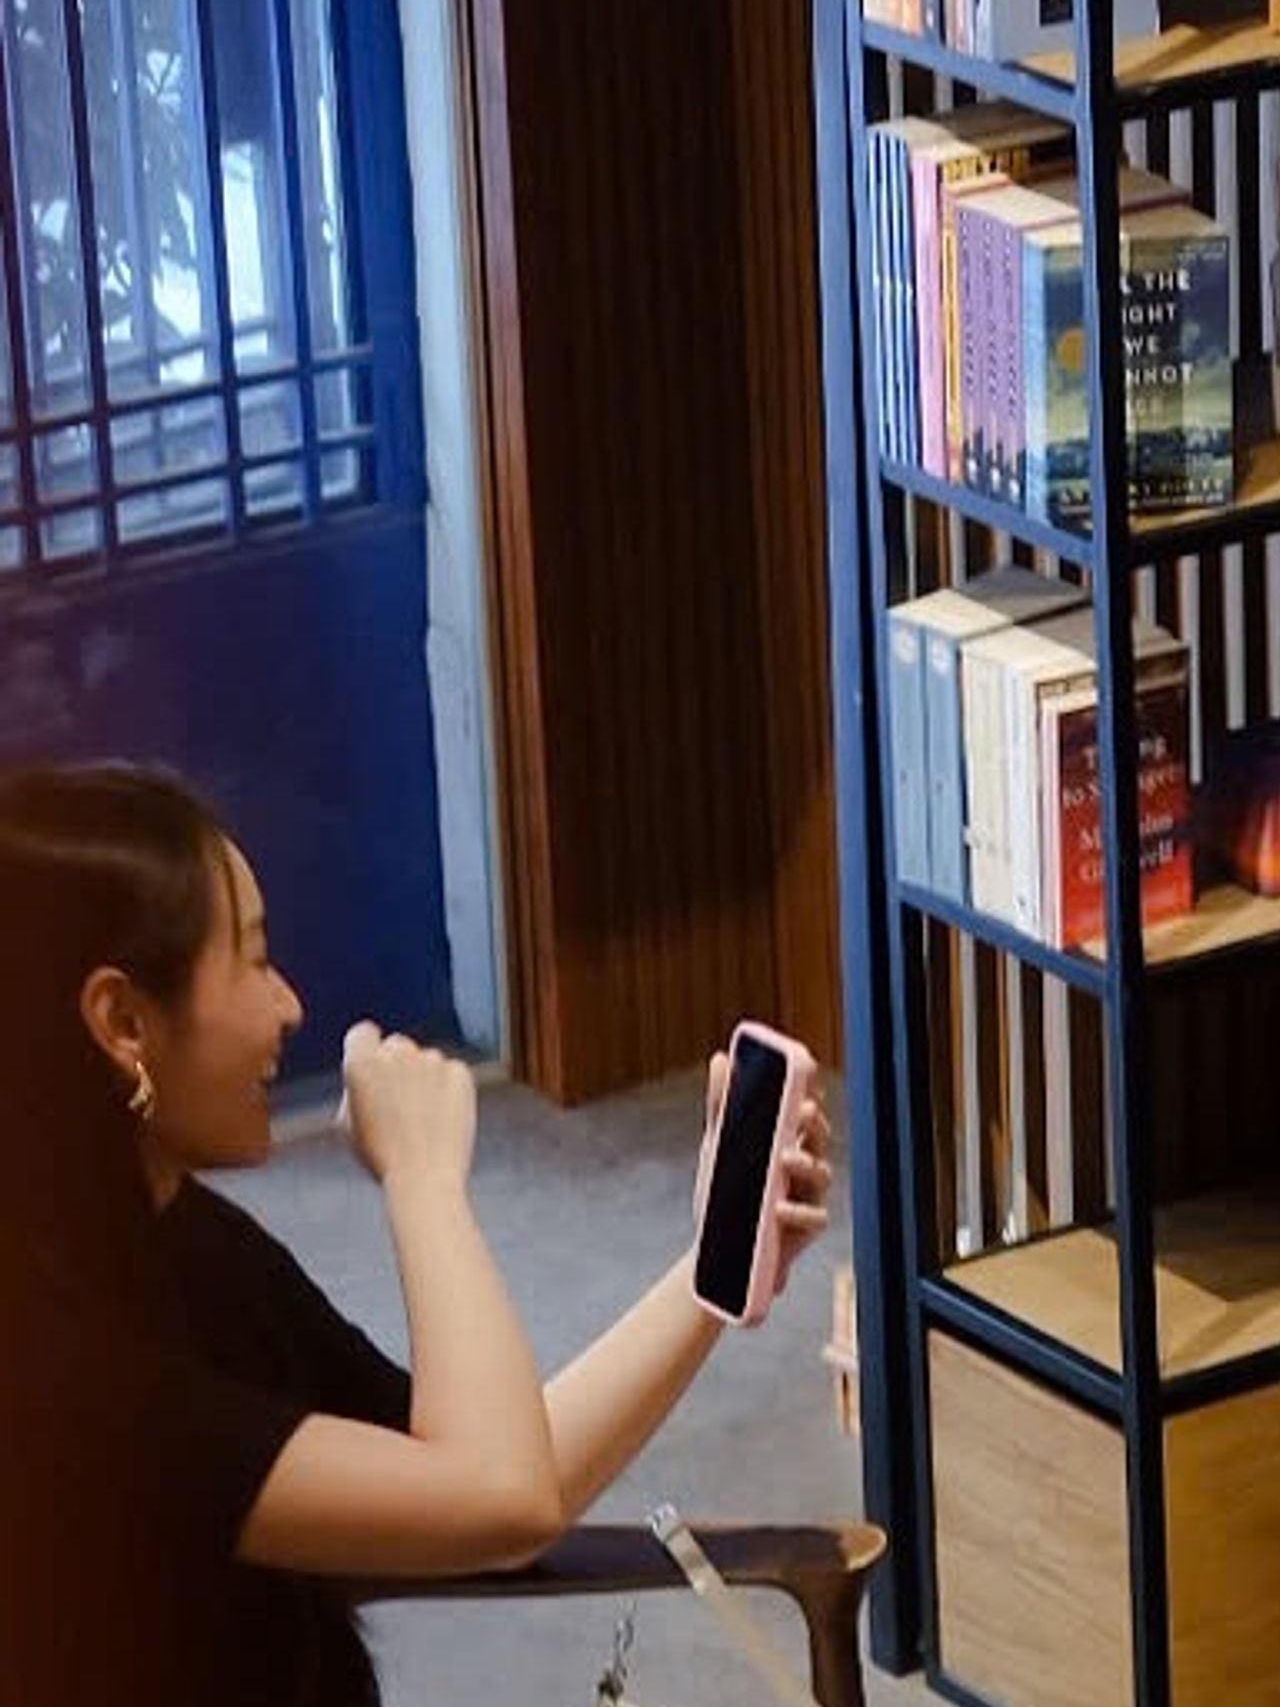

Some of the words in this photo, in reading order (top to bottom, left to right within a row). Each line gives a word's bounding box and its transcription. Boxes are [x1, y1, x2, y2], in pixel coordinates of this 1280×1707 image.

[1144, 267, 1191, 291] THE
[1121, 302, 1178, 325] IGHT
[1125, 362, 1194, 388] NNOT
